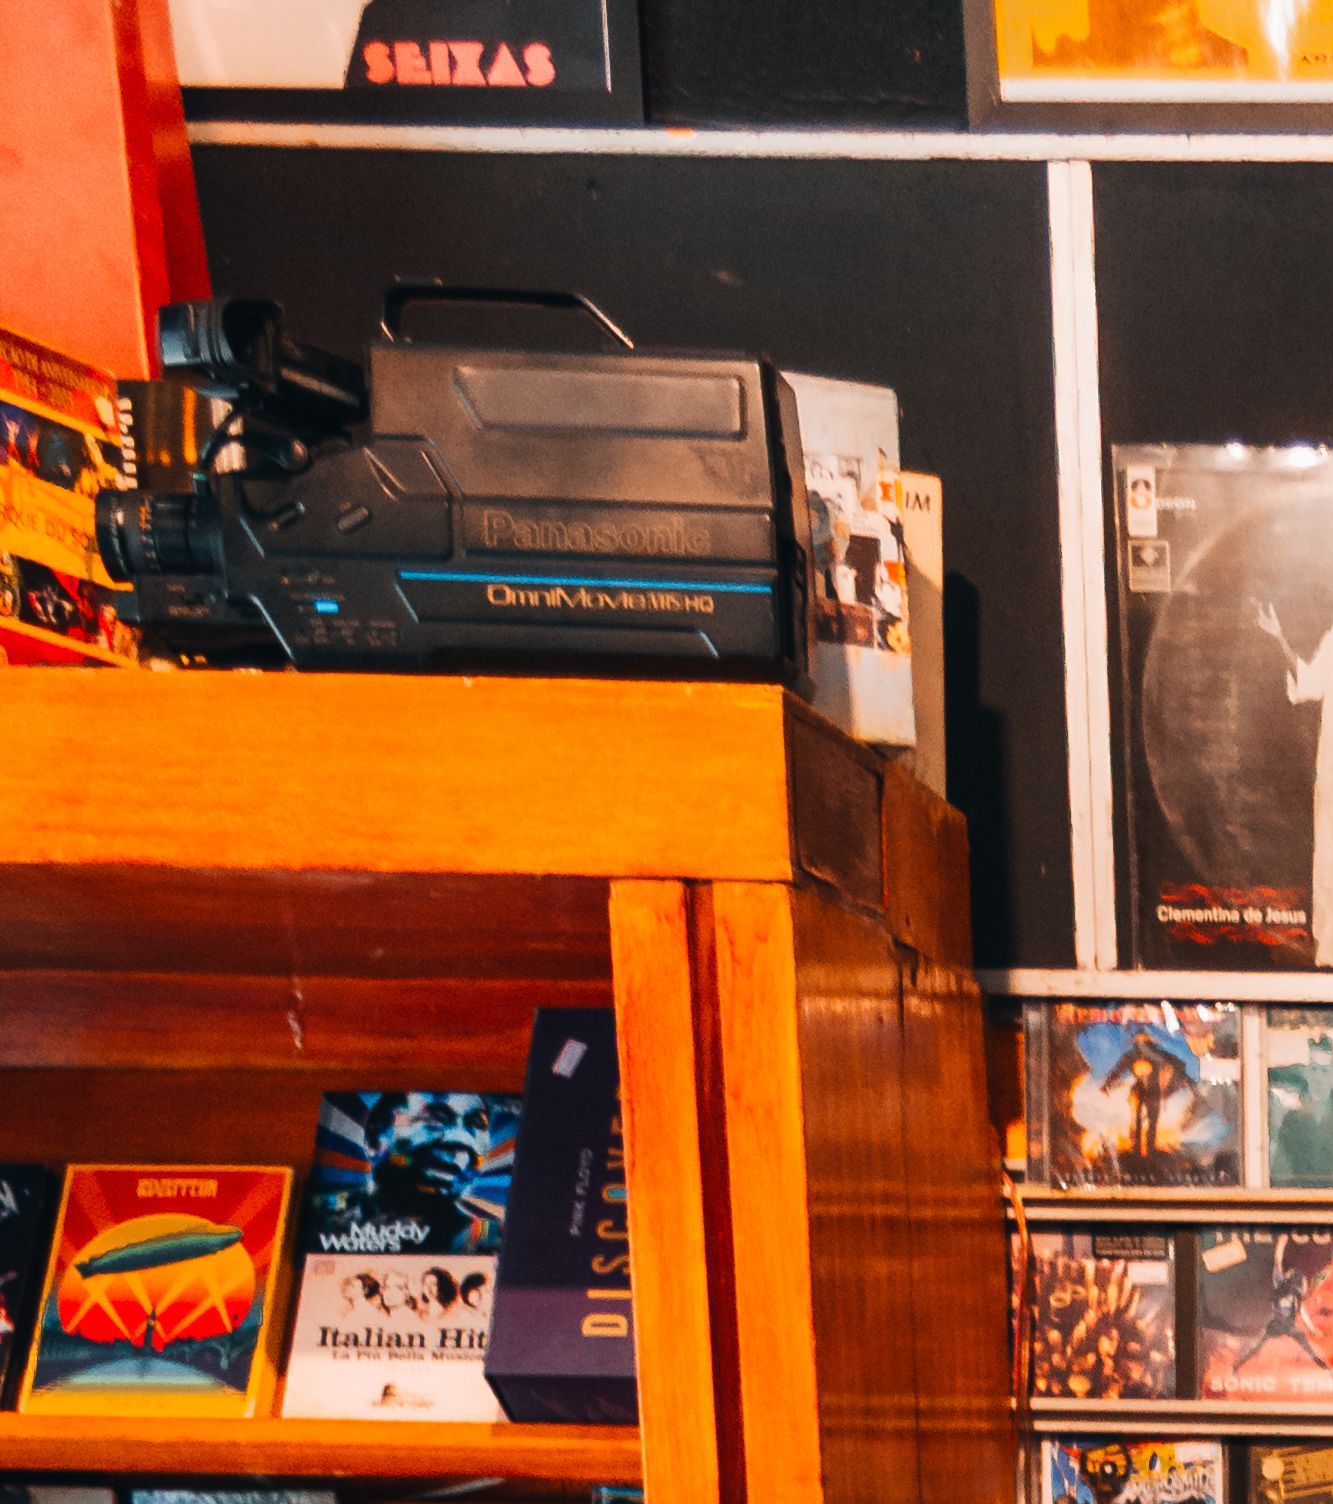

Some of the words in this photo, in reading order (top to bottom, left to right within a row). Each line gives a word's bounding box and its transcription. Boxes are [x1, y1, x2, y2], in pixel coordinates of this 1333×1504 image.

[363, 41, 556, 87] SEIXAS
[482, 509, 711, 555] Panasonic
[350, 1220, 430, 1245] Muddy
[316, 1326, 424, 1350] Italian
